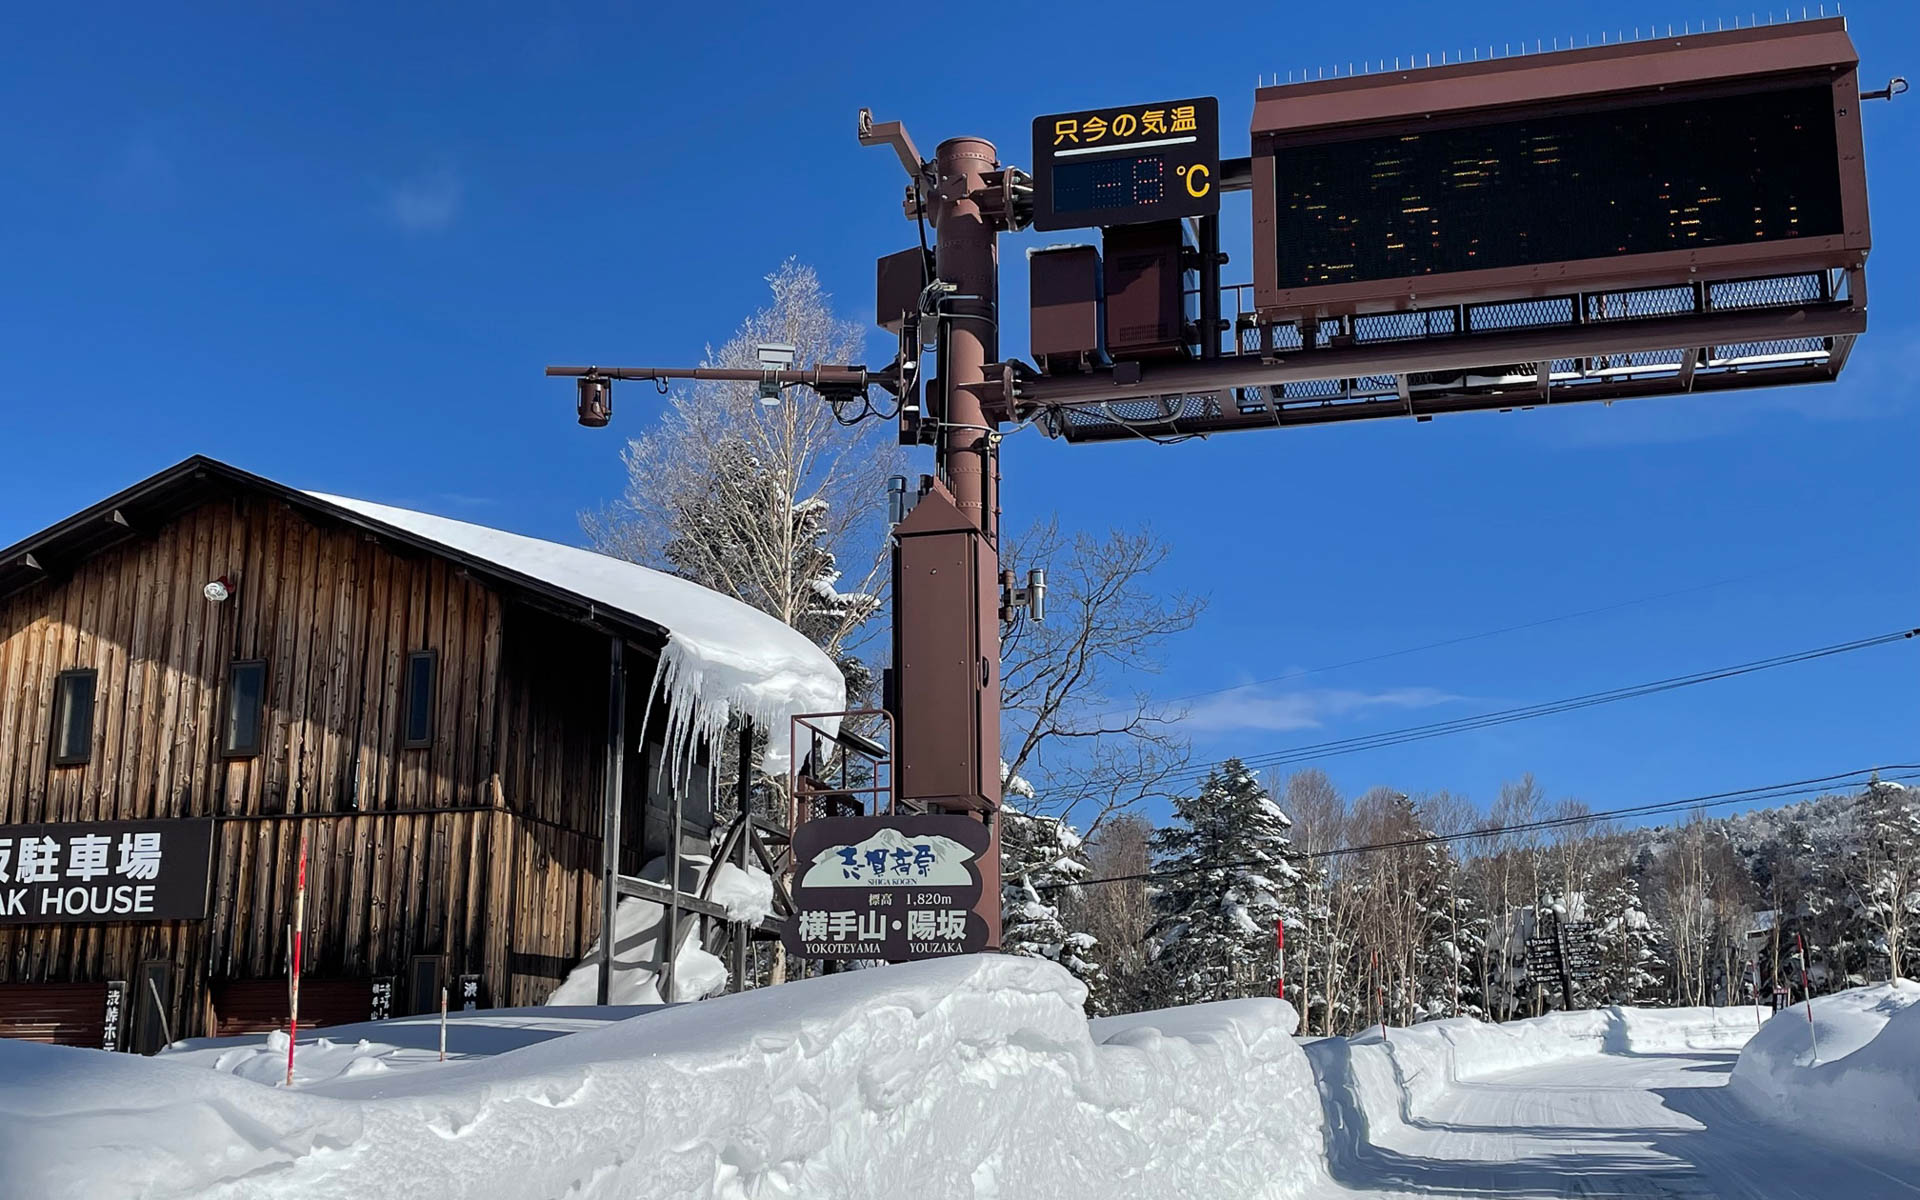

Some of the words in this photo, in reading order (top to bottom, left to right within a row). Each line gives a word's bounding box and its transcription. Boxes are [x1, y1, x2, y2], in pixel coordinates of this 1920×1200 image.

[1053, 105, 1197, 146] 只今の気温
[836, 844, 936, 880] 志賀高原
[868, 878, 891, 886] SHIGA
[892, 878, 917, 886] KOGEN
[40, 885, 156, 915] HOUSE
[868, 893, 893, 906] 標高
[905, 893, 952, 906] 1,820m
[805, 943, 881, 954] YOKOTEYAMA
[909, 942, 963, 953] YOUZAKA
